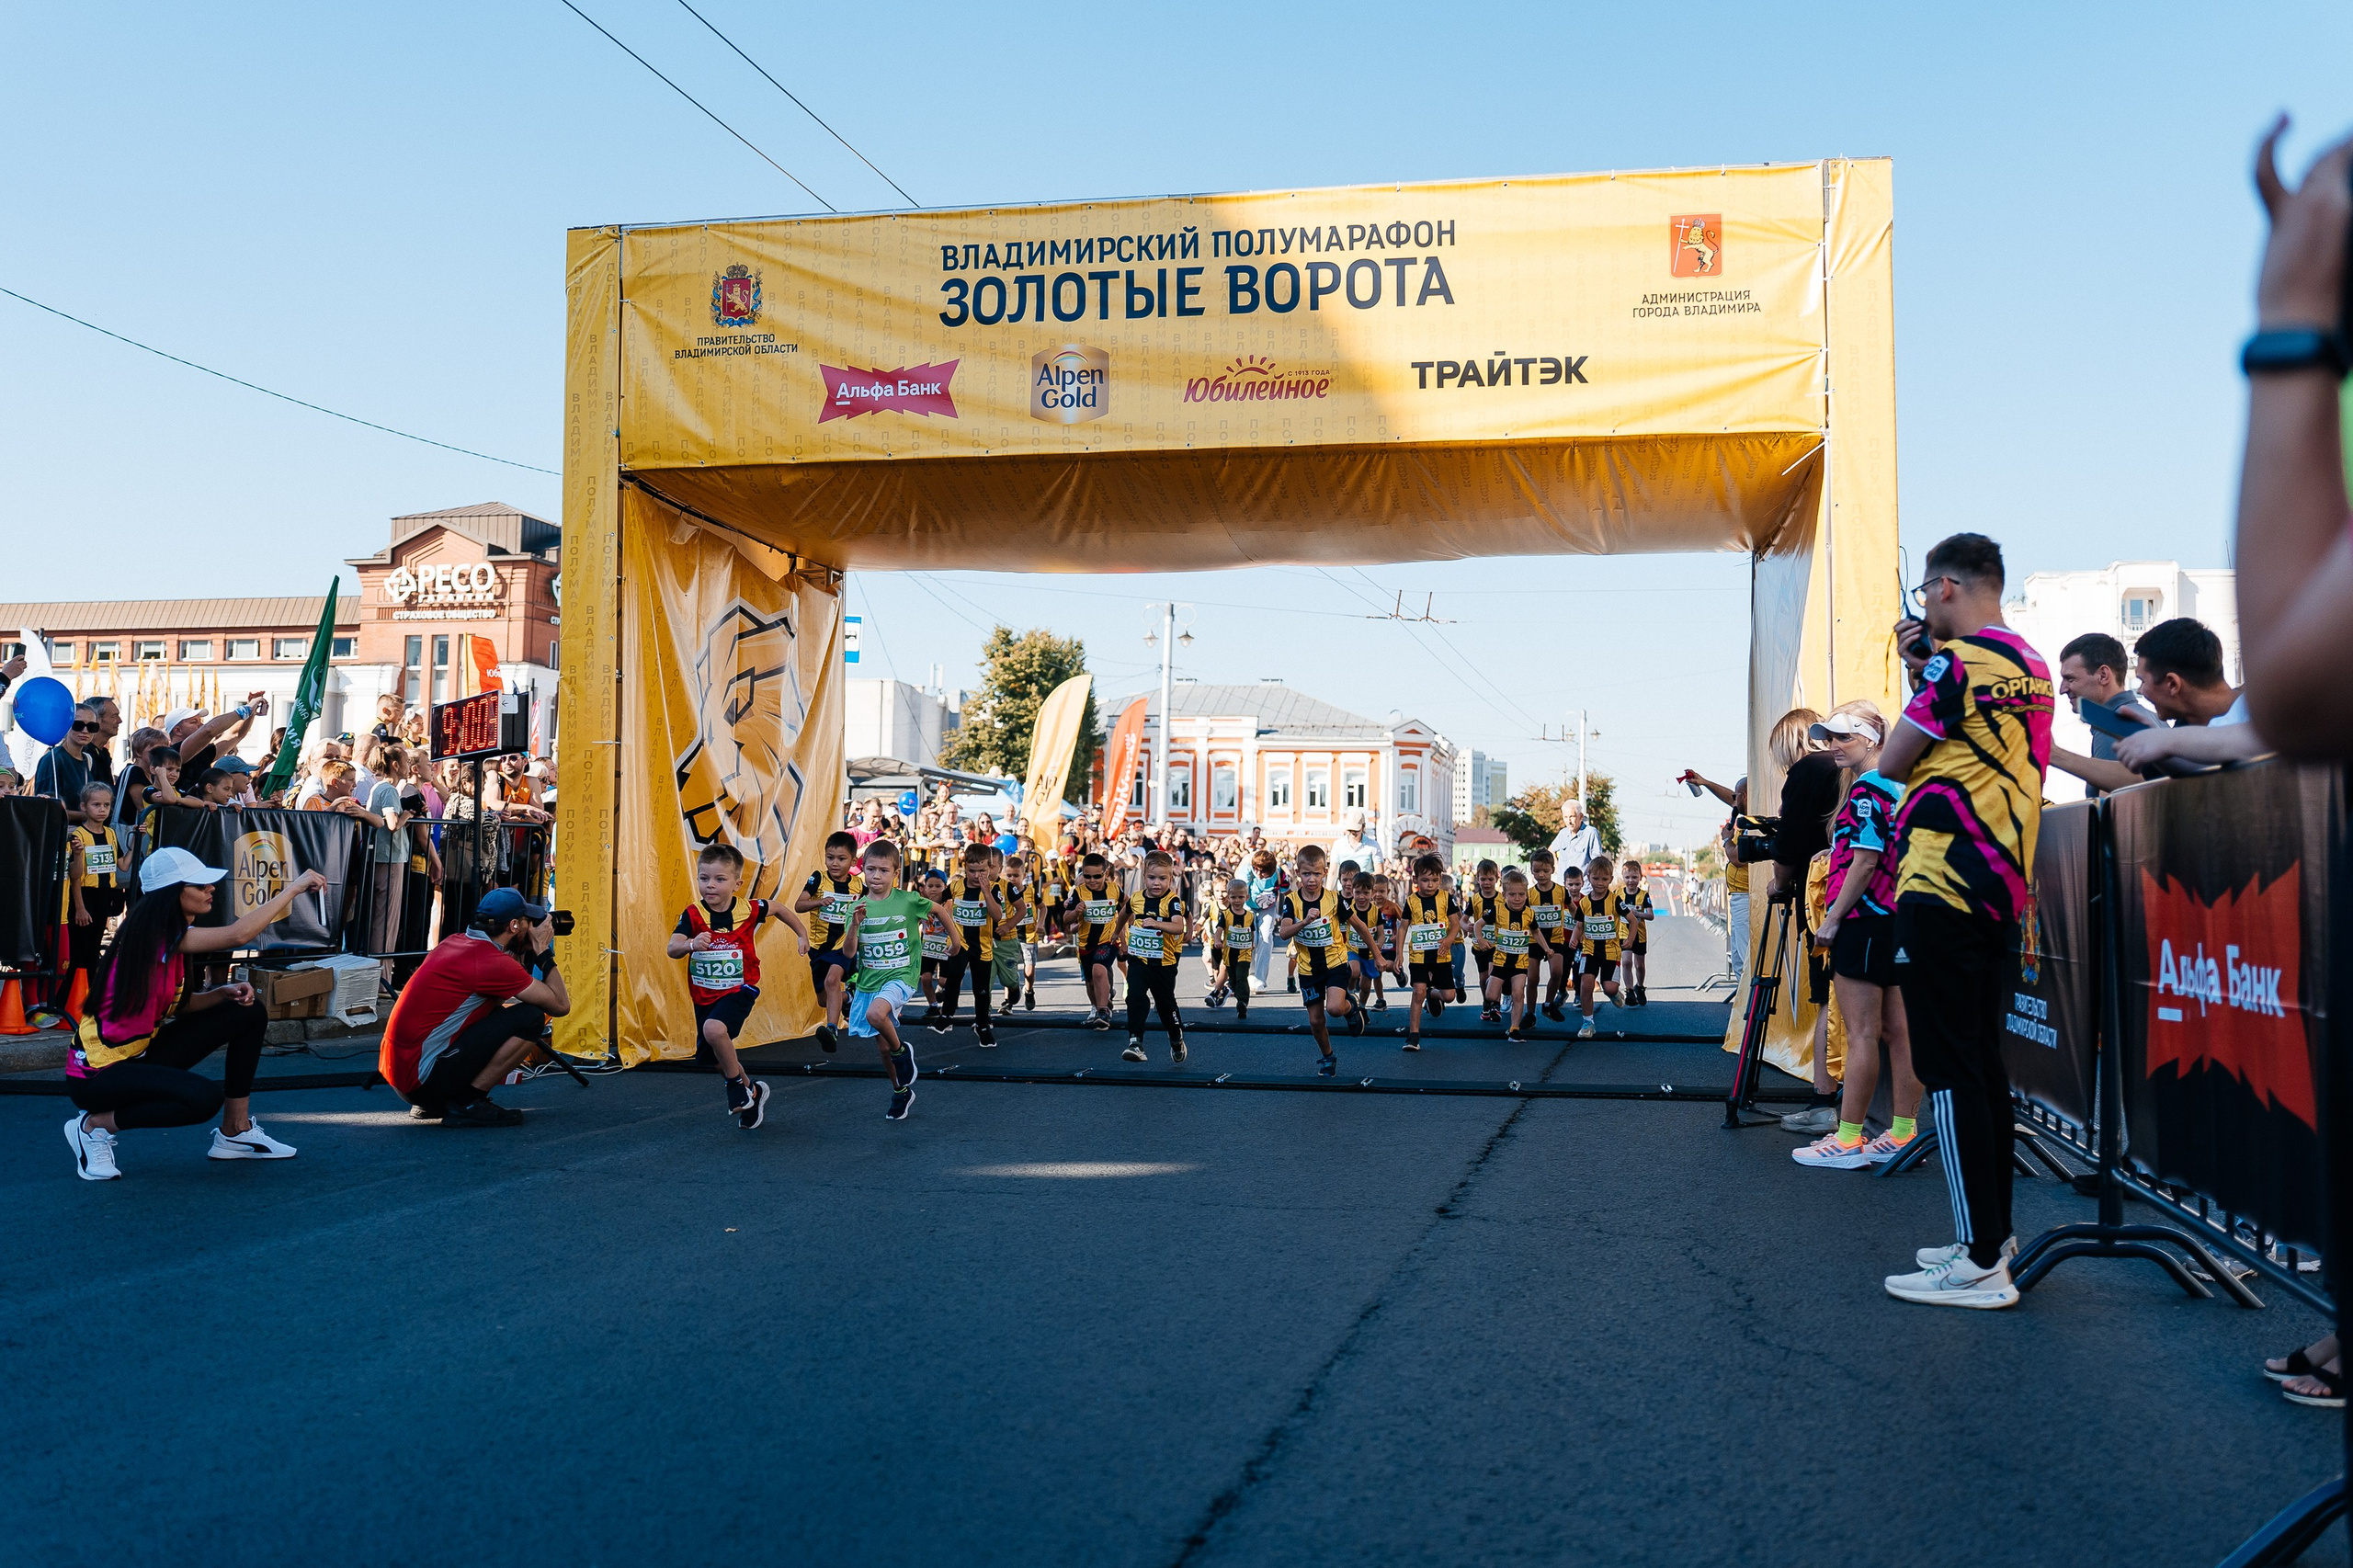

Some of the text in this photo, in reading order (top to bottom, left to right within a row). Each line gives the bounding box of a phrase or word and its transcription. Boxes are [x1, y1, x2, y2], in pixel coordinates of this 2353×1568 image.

[940, 220, 1455, 271] ВЛАДИМИРСКИЙ ПОЛУМАРАФОН
[938, 256, 1455, 327] ЗОЛОТЫЕ ВОРОТА
[1642, 290, 1751, 305] АДМИНИСТРАЦИЯ
[1632, 302, 1761, 318] ГОРОДА ВЛАДИМИРА
[697, 334, 776, 347] ПРАВИТЕЛЬСТВО
[675, 343, 798, 359] ВЛАДИМИРСКОЙ ОБЛАСТИ
[1036, 363, 1104, 392] Alpen
[1411, 351, 1589, 390] ТРАЙТЭК
[836, 380, 941, 401] Альфа Банк
[1183, 372, 1330, 403] Юбилейное
[1041, 386, 1097, 409] Gold
[418, 562, 496, 593] РЕСО
[417, 593, 494, 603] ГАРАНТИЯ
[392, 609, 496, 620] СТРАХОВОЕ ОБЩЕСТВО
[92, 852, 114, 864] 5136
[238, 851, 289, 884] Alpen
[242, 881, 285, 906] Gold
[826, 903, 851, 914] 514
[956, 908, 983, 918] 5014
[1086, 907, 1114, 917] 5064
[1586, 923, 1612, 932] 5089
[1131, 936, 1159, 949] 5055
[1230, 933, 1250, 942] 5103
[1416, 930, 1442, 942] 5163
[1502, 937, 1526, 946] 5127
[864, 942, 904, 958] 5059
[696, 962, 735, 976] 5120
[2158, 938, 2285, 1018] Альфа Банк
